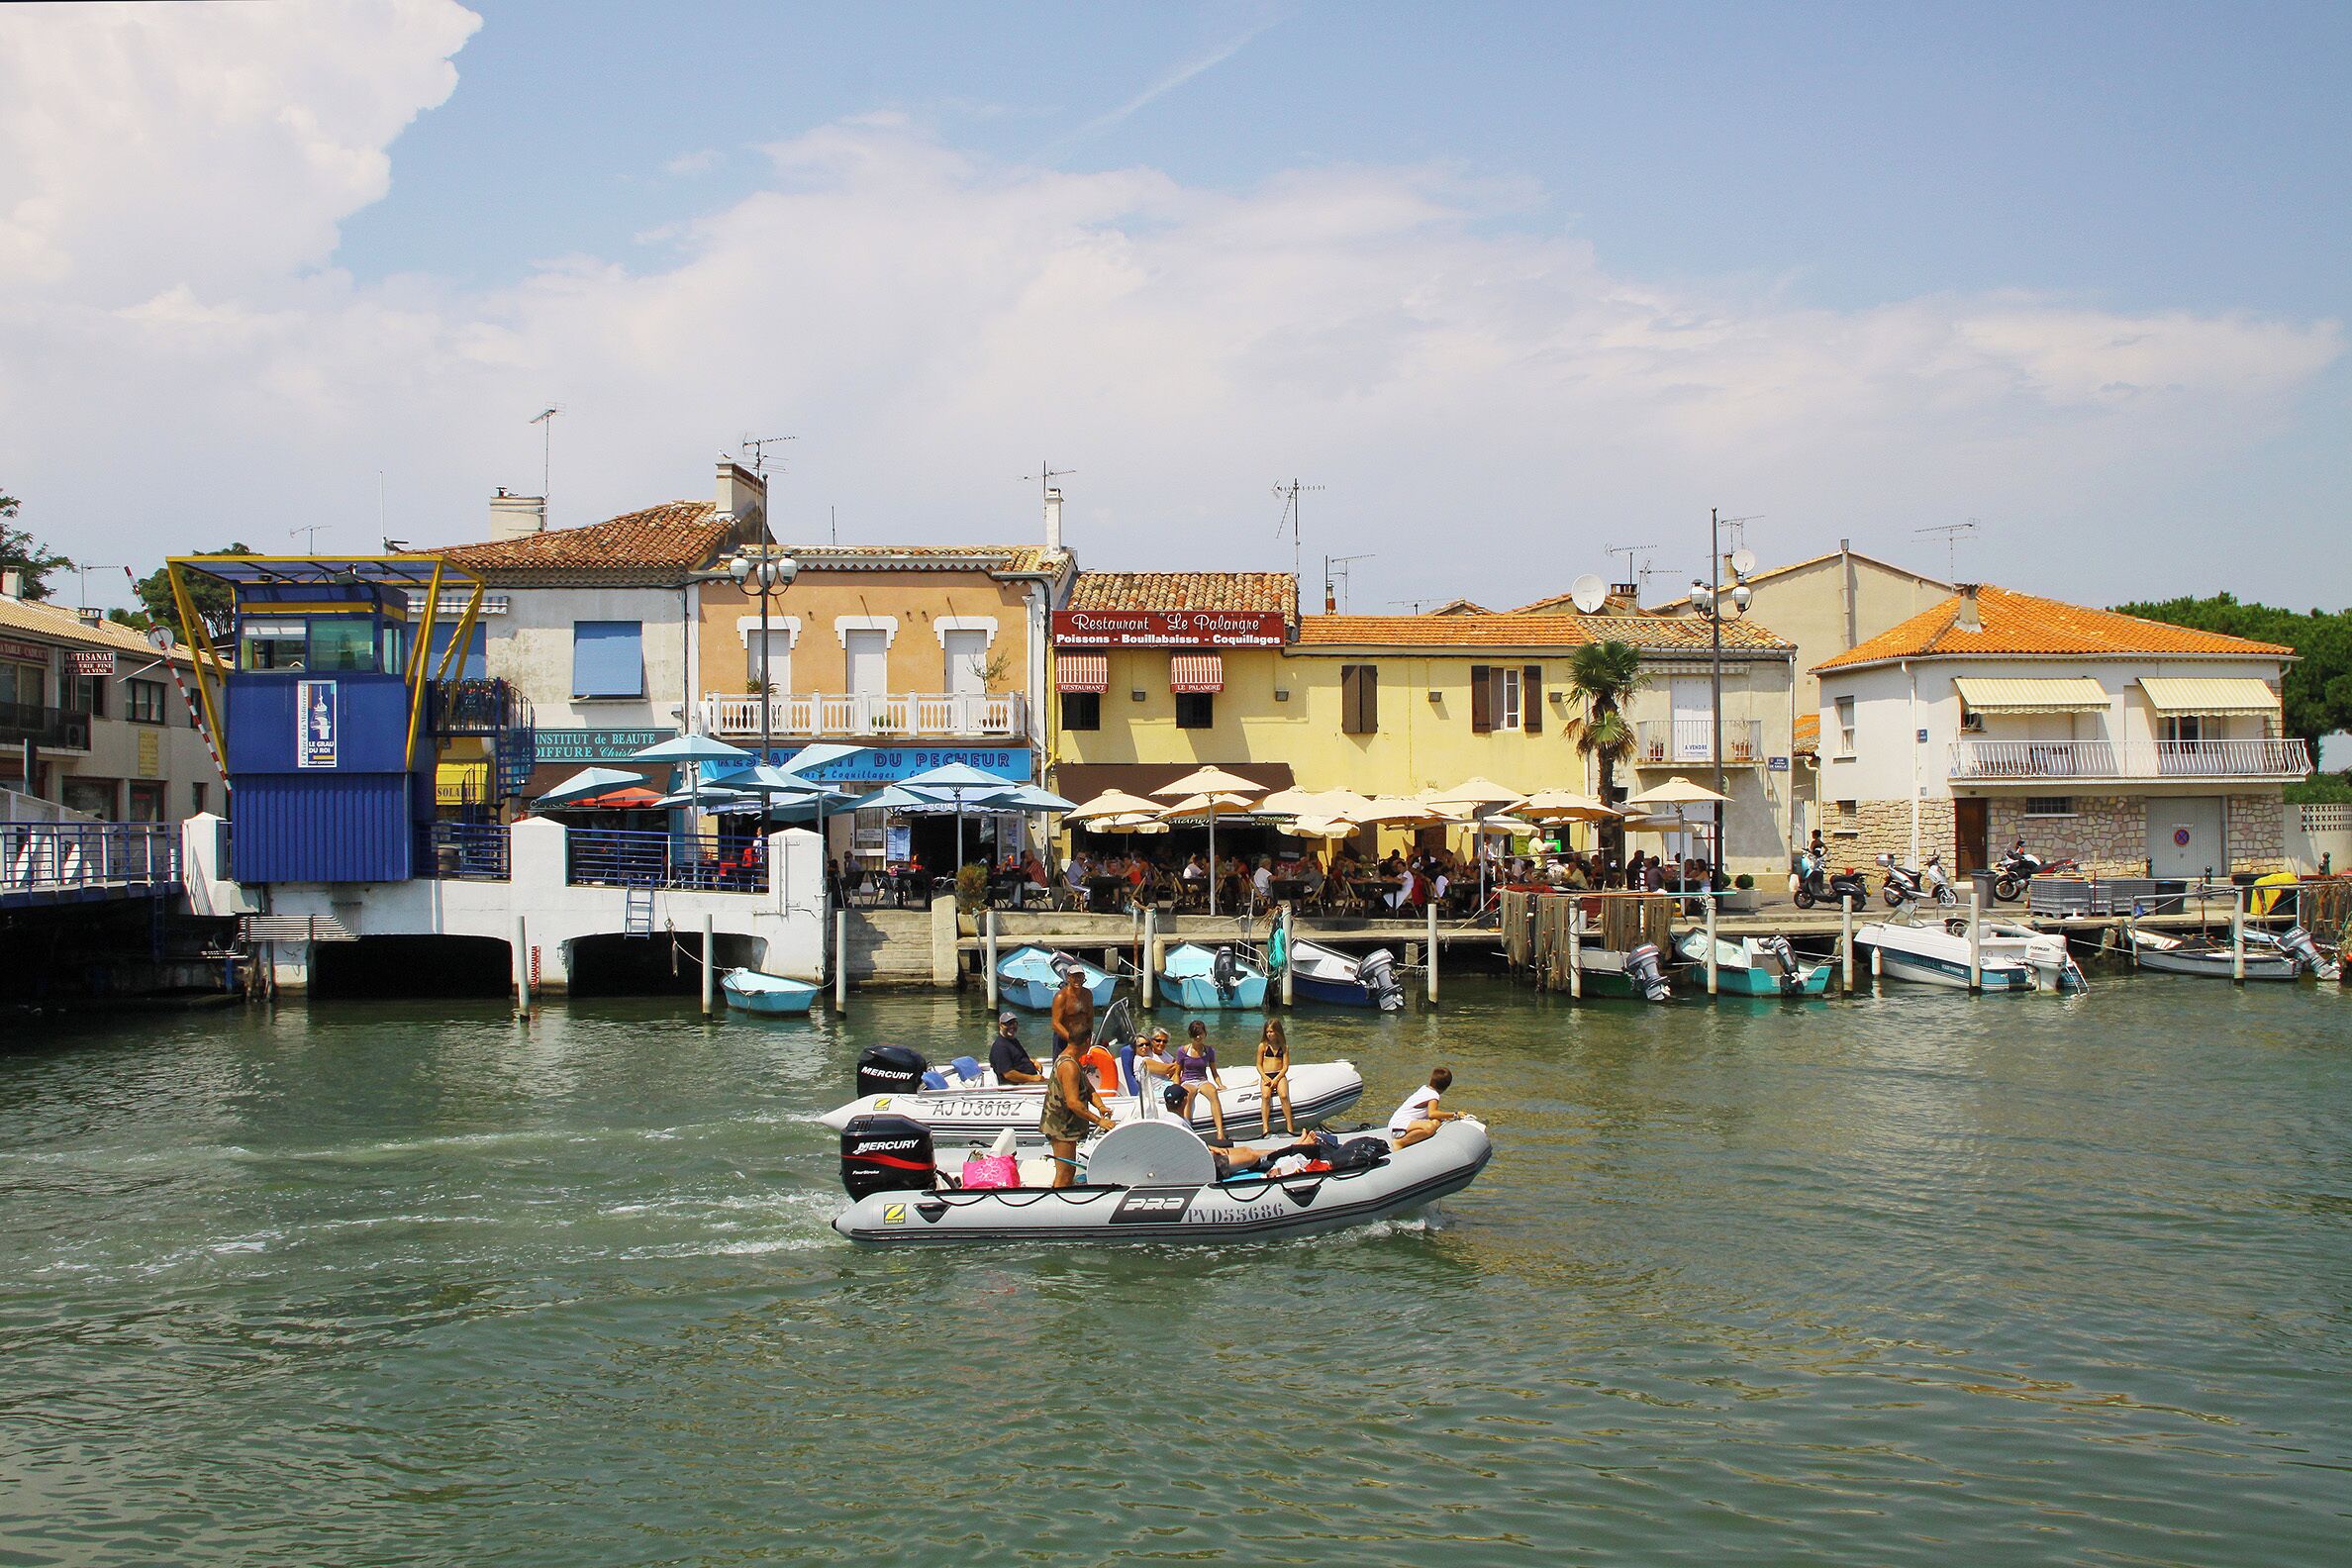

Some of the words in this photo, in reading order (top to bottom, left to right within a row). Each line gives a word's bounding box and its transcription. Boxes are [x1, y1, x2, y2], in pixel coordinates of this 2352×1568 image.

[1071, 613, 1149, 631] Restaurant
[1056, 634, 1110, 643] Poissons
[1122, 634, 1200, 643] Bouillabaisse
[1213, 635, 1281, 645] Coquillages
[595, 734, 607, 744] de
[613, 734, 655, 744] BEAUTE
[874, 752, 902, 767] DU
[861, 1066, 913, 1080] MERCURY
[853, 1139, 920, 1155] MERCURY
[1124, 1197, 1185, 1211] PRO
